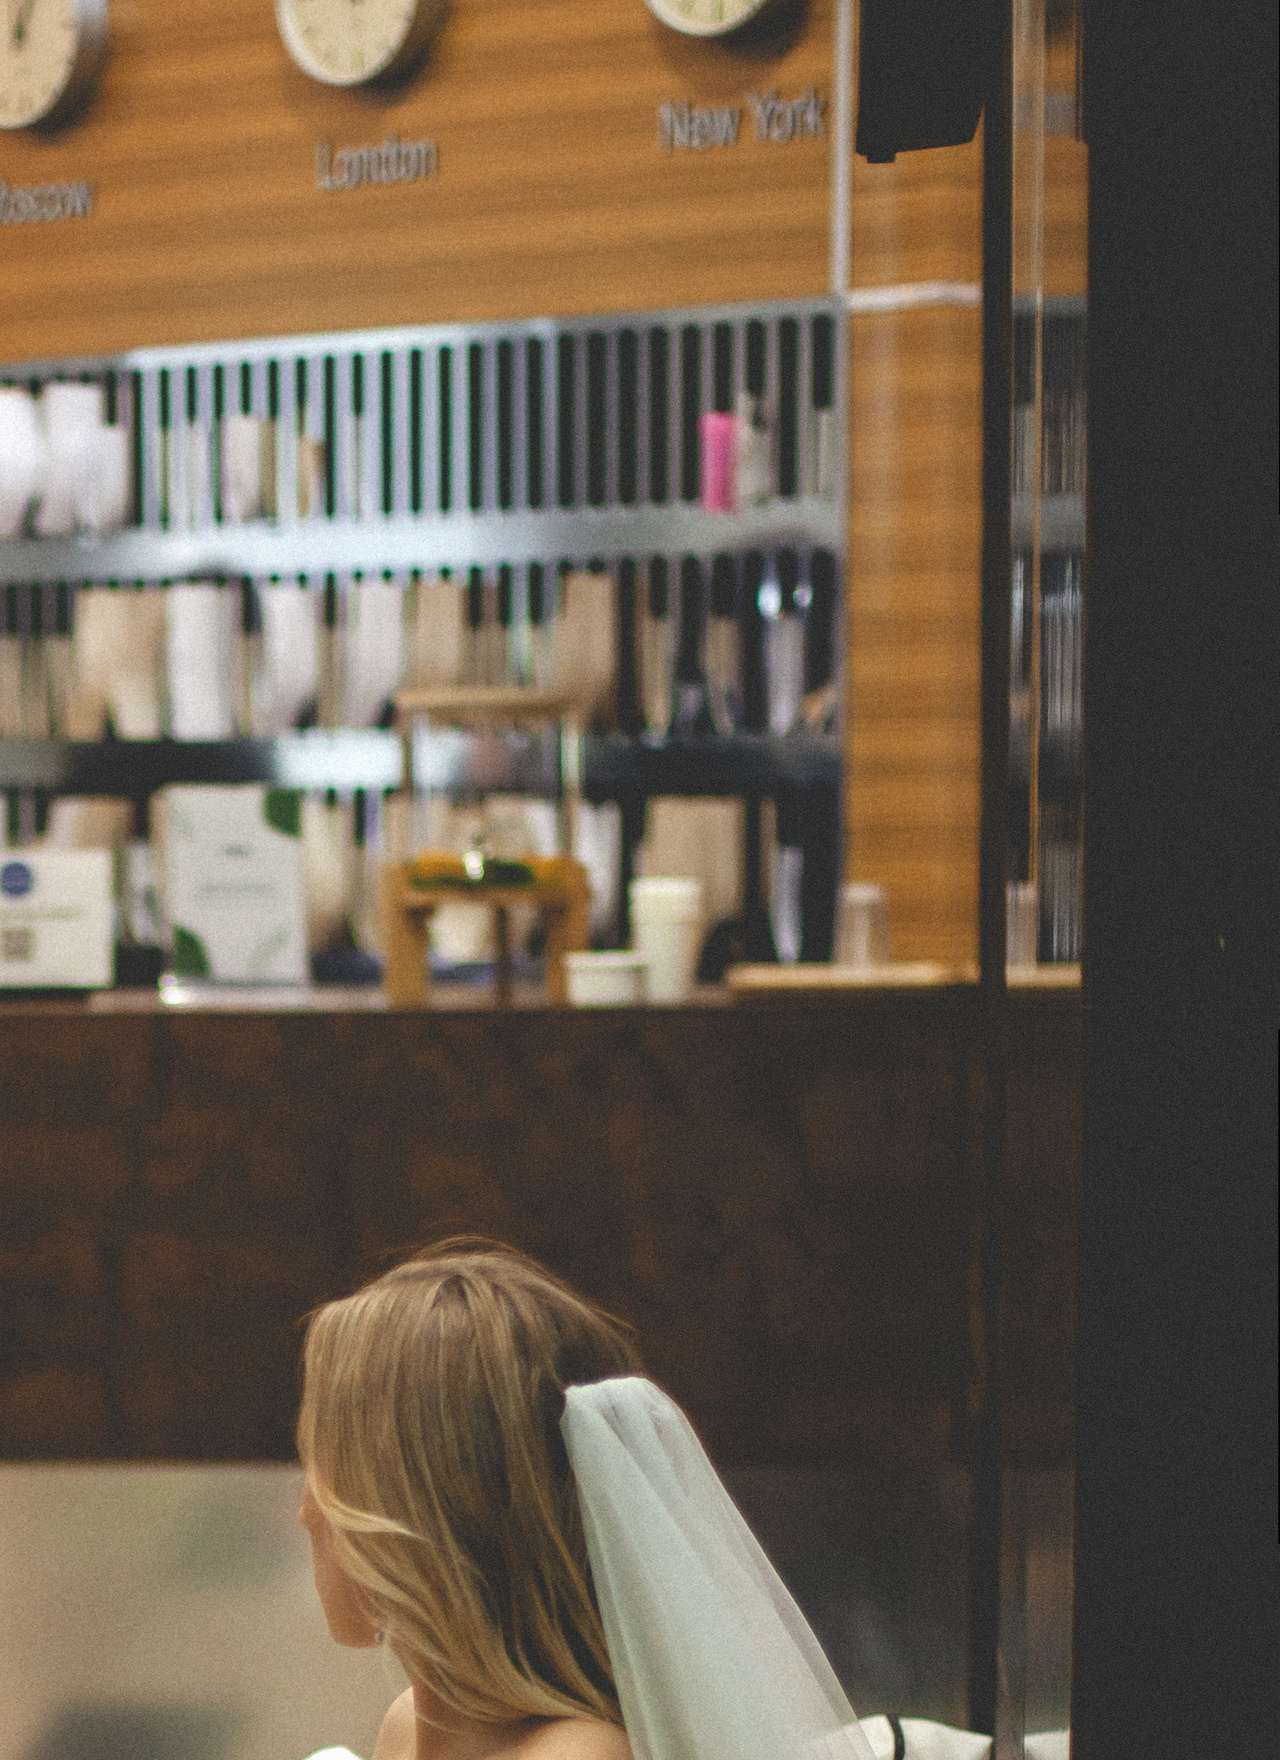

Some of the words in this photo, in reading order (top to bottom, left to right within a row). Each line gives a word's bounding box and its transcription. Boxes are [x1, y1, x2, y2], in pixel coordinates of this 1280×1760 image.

[658, 99, 742, 150] New
[746, 86, 826, 142] York
[316, 134, 437, 190] London
